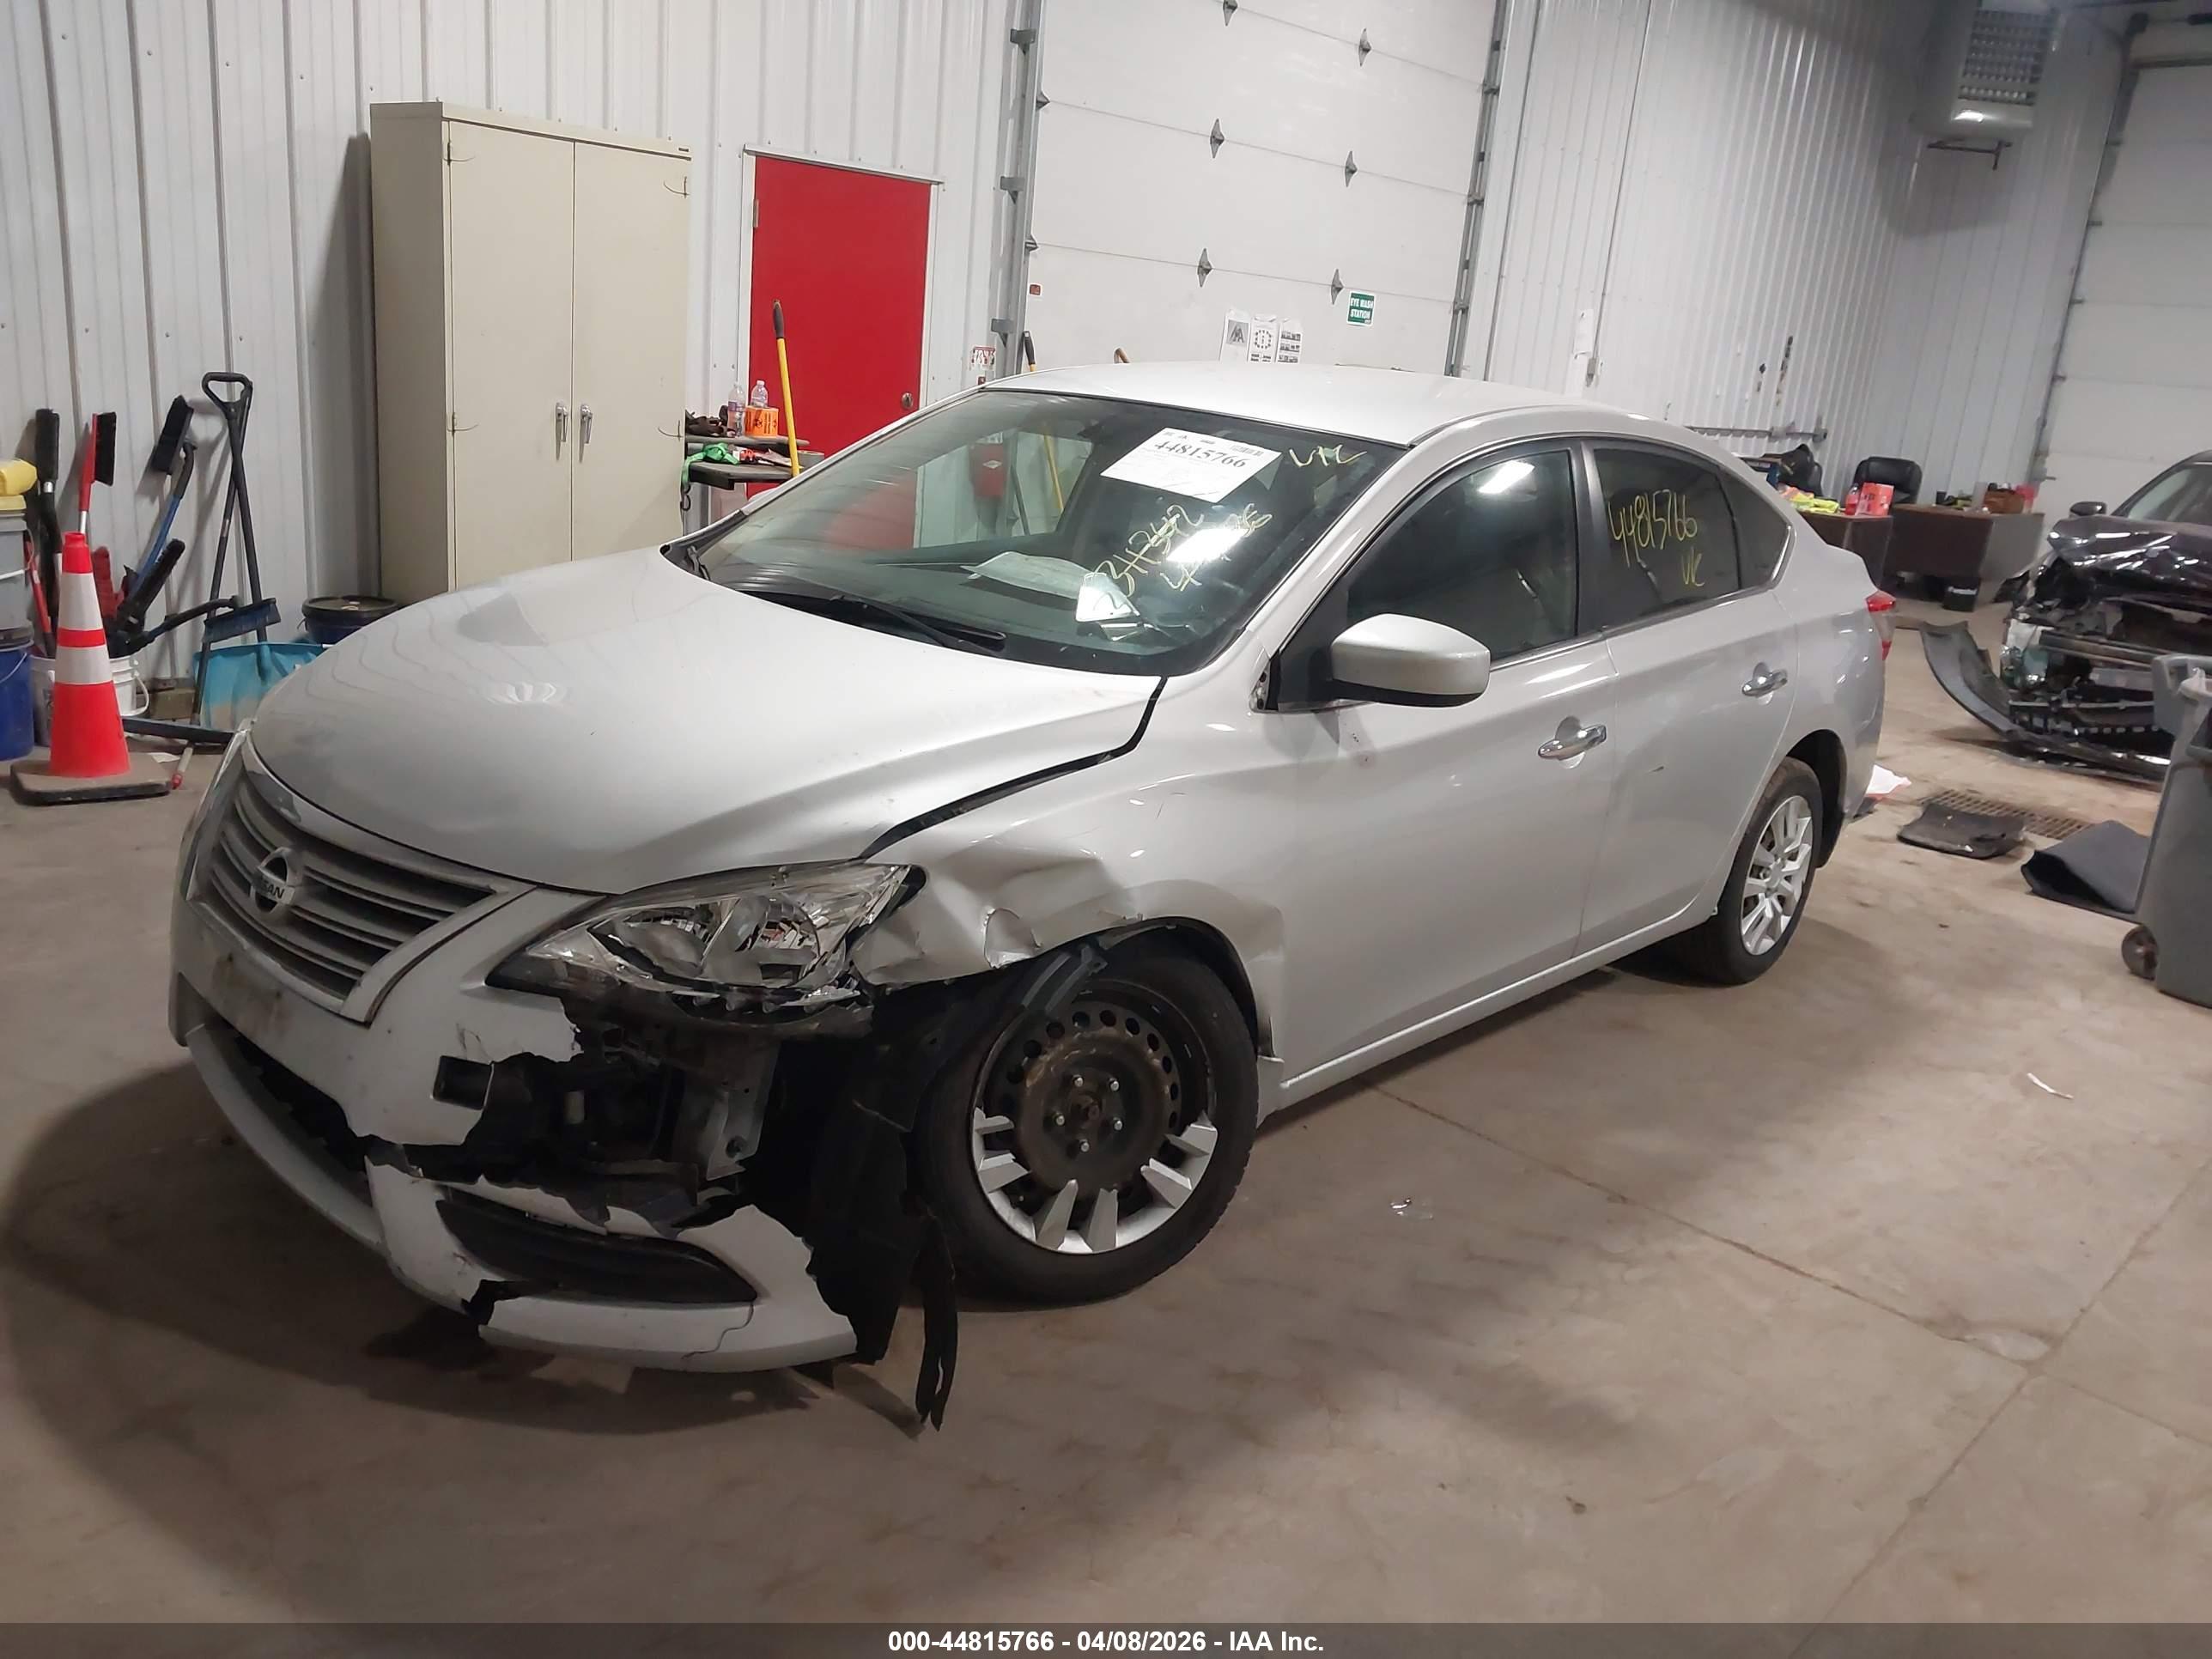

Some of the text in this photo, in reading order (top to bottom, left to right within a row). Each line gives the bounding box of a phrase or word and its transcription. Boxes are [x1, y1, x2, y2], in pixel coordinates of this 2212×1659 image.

[1350, 297, 1374, 309] EYE WASH
[1350, 308, 1371, 319] STATION
[1155, 441, 1249, 468] 44815766
